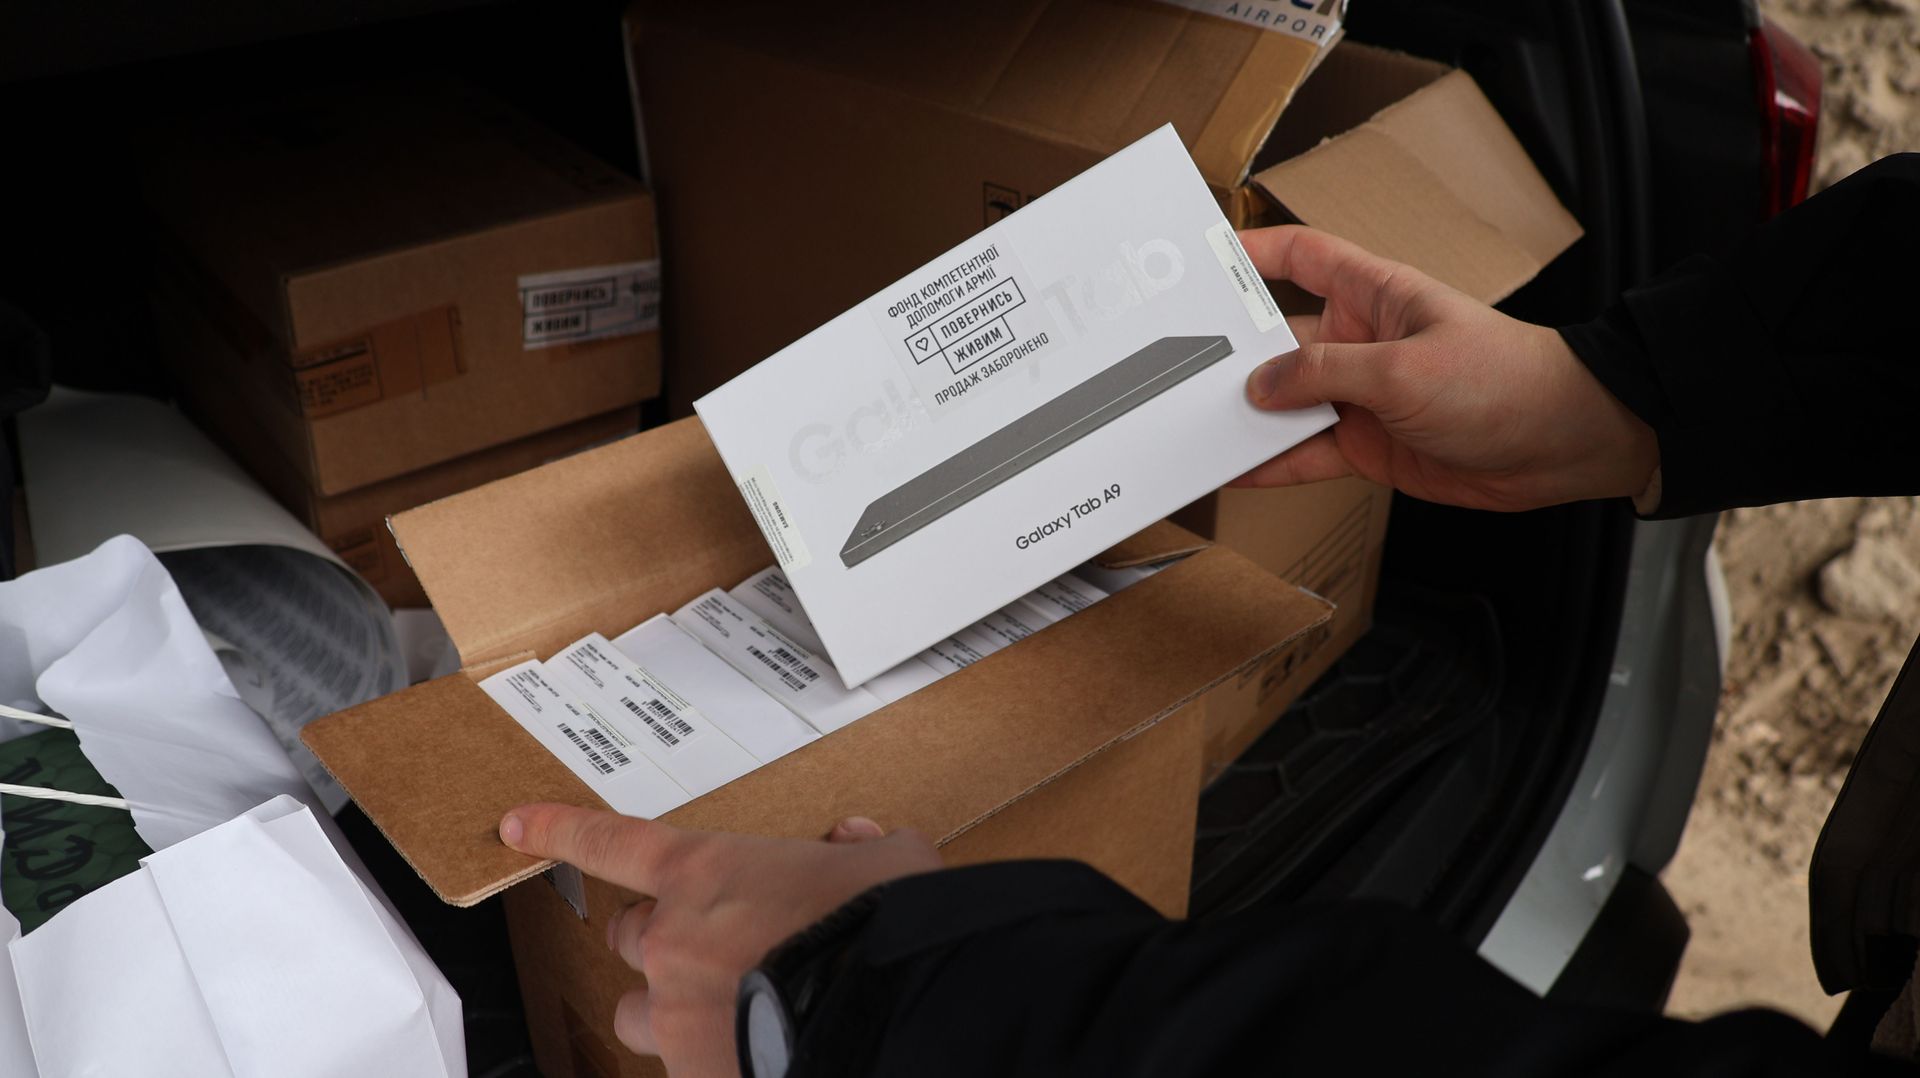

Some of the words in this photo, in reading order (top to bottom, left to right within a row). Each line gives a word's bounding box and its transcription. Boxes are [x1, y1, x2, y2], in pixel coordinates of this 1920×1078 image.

[1226, 3, 1327, 40] AIRPOR
[532, 285, 606, 308] ПОВЕРНИСЬ
[887, 293, 922, 319] ФОНД
[919, 243, 1000, 298] КОМПЕТЕНТНОЇ
[905, 284, 965, 329] ДОПОМОГИ
[965, 265, 997, 294] АРМІЇ
[1230, 264, 1249, 293] SAMSUNG
[940, 290, 1013, 339] ПОВЕРНИСЬ
[934, 371, 983, 405] ПРОДАЖ
[980, 332, 1050, 376] ЗАБОРОНЕНО
[953, 326, 1004, 363] ЖИВИМ
[1016, 513, 1071, 549] Galaxy
[1070, 497, 1101, 518] Tab
[1103, 483, 1121, 504] A9
